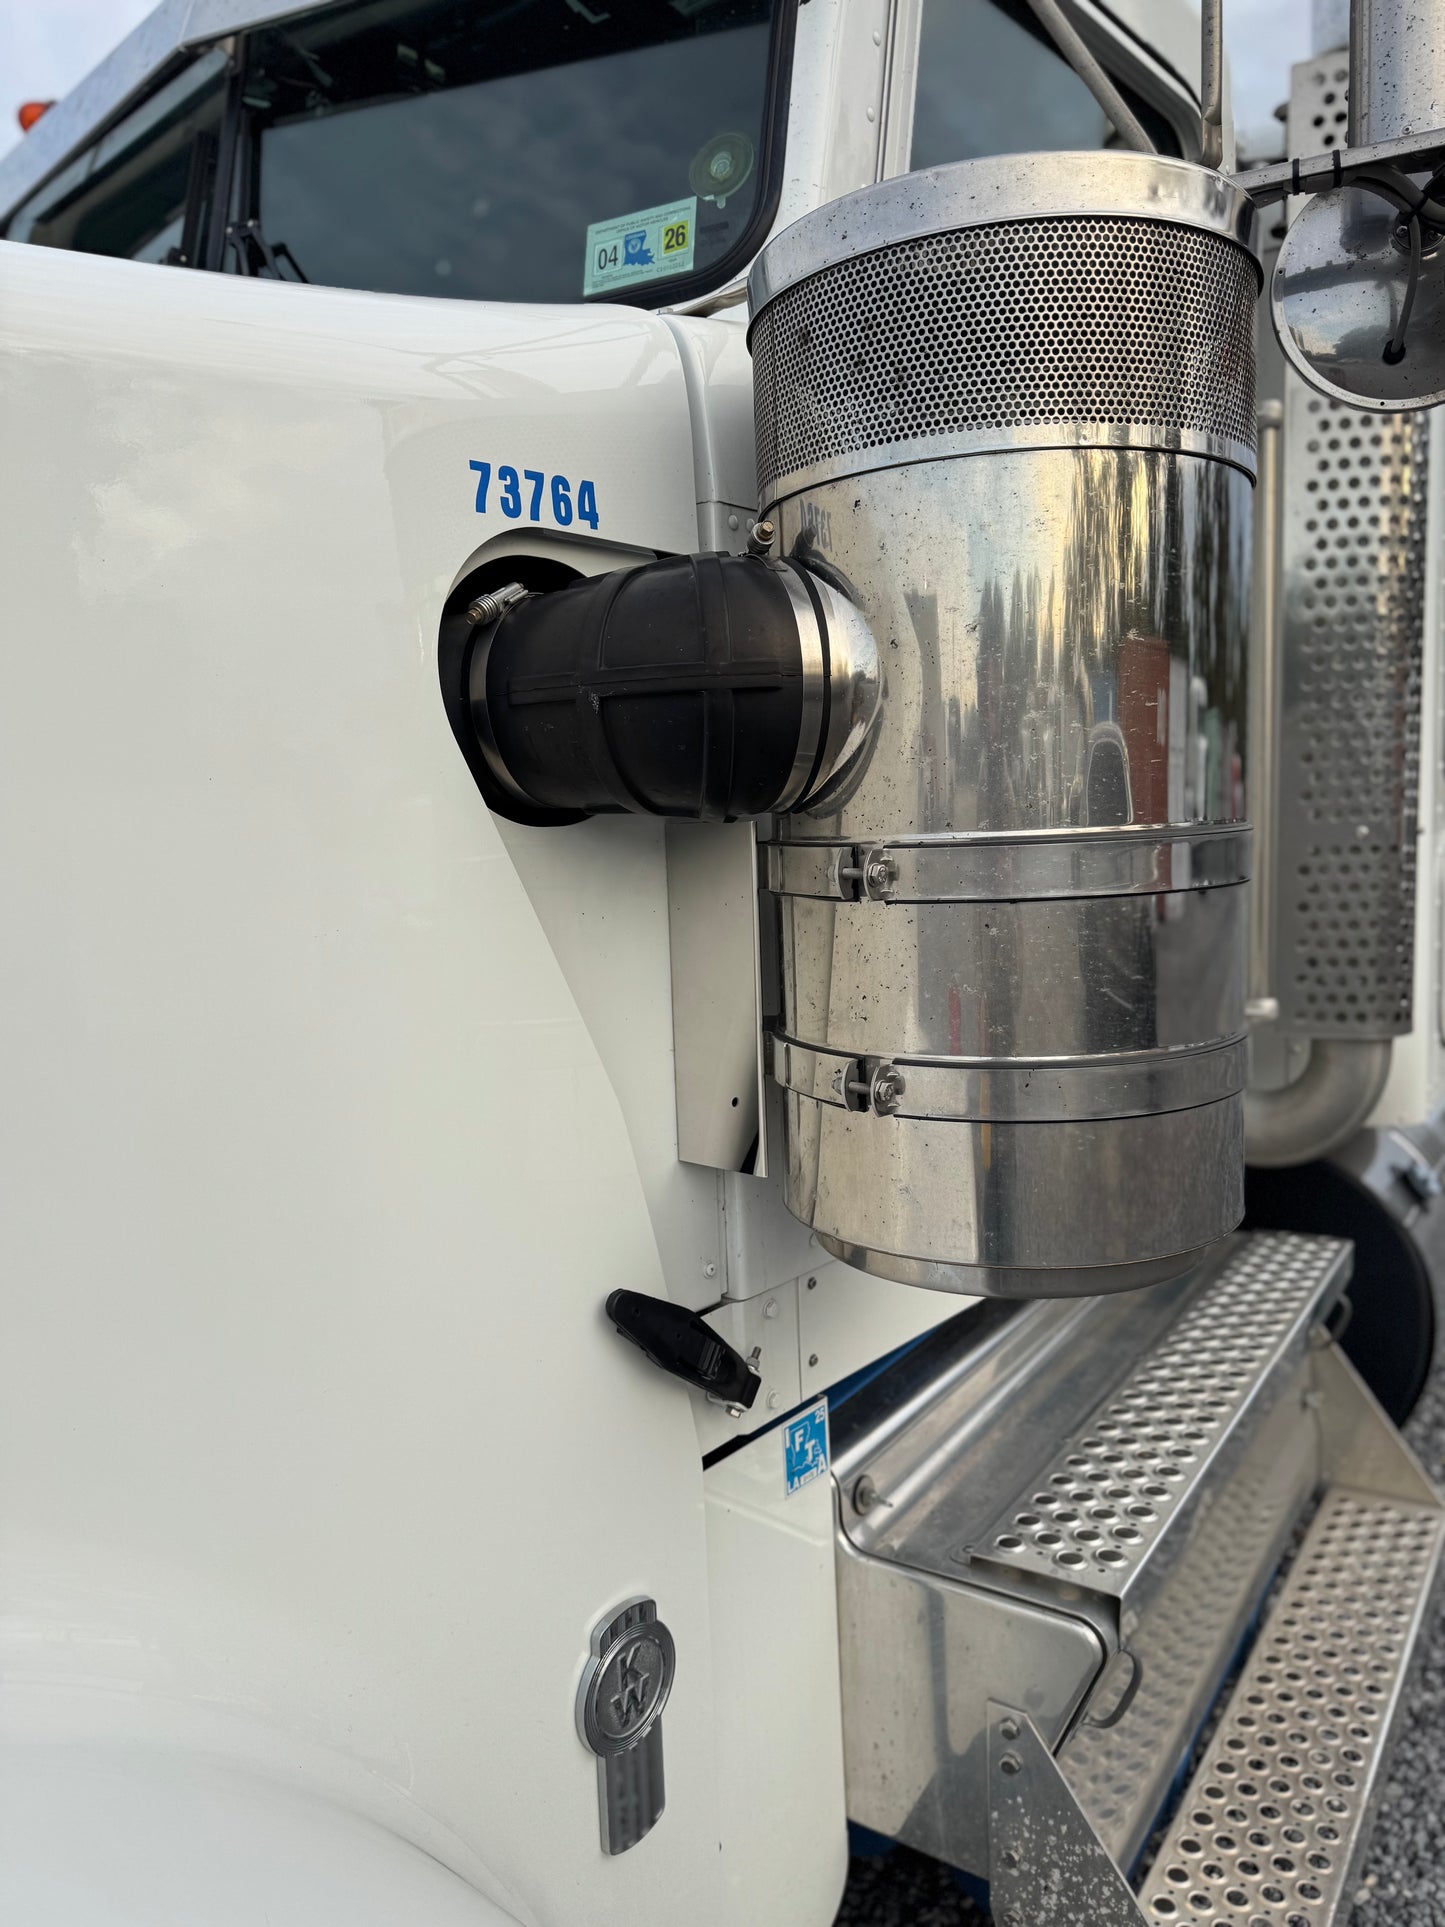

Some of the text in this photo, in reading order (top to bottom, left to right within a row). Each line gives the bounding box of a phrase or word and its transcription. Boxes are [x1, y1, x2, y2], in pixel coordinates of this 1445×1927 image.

[664, 224, 686, 251] 26
[598, 245, 618, 270] 04
[469, 460, 599, 530] 73764
[814, 1407, 825, 1424] 25
[788, 1476, 800, 1493] LA
